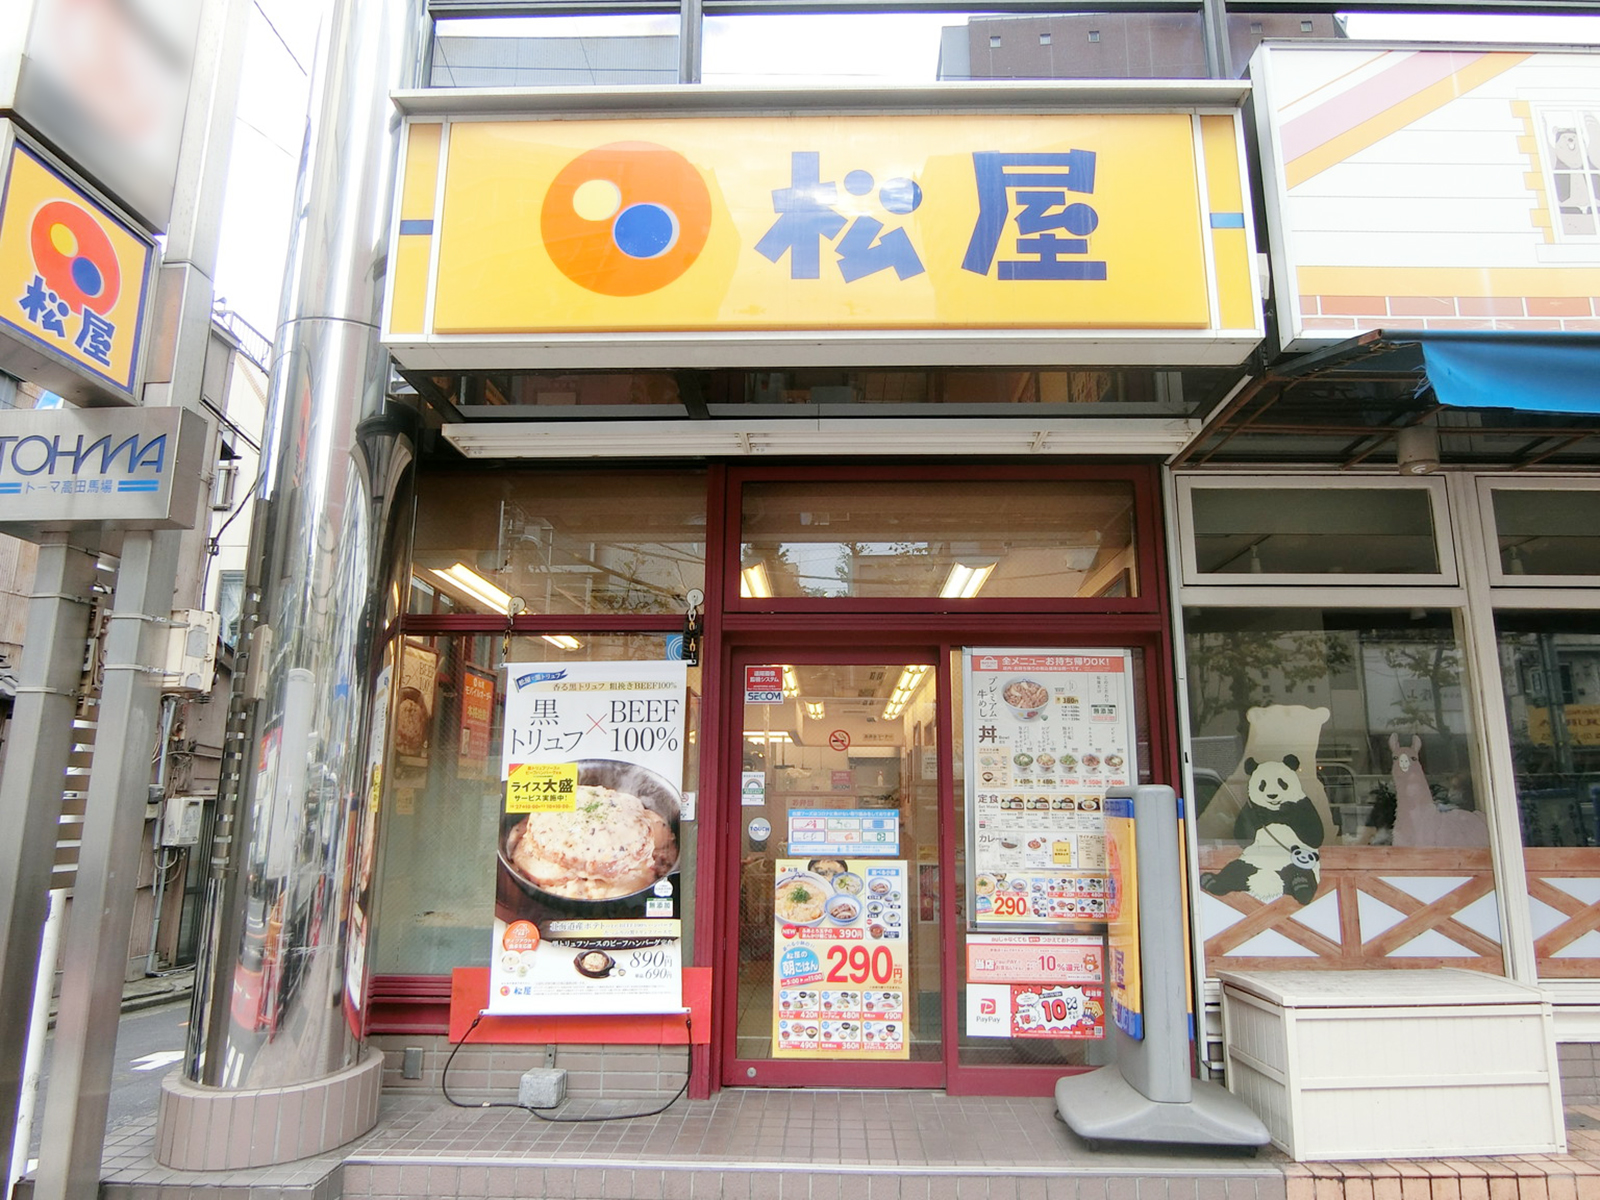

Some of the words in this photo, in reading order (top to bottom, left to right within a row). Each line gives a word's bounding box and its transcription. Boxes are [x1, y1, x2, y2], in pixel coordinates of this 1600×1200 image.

[754, 149, 1107, 283] 松屋
[18, 274, 116, 367] 松屋
[25, 480, 113, 493] トーマ高田馬場
[553, 682, 605, 691] 香る黒トリュフ
[747, 692, 781, 701] SECOM
[530, 699, 560, 726] 黒
[609, 699, 679, 723] BEEF
[511, 727, 584, 755] トリュフ
[610, 726, 678, 752] 100%
[979, 725, 998, 744] 丼
[511, 778, 574, 793] ライス大盛
[977, 794, 999, 804] 定食
[994, 897, 1027, 915] 290
[782, 959, 819, 976] 朝ごはん
[826, 944, 894, 984] 290
[976, 1015, 1001, 1023] PayPay
